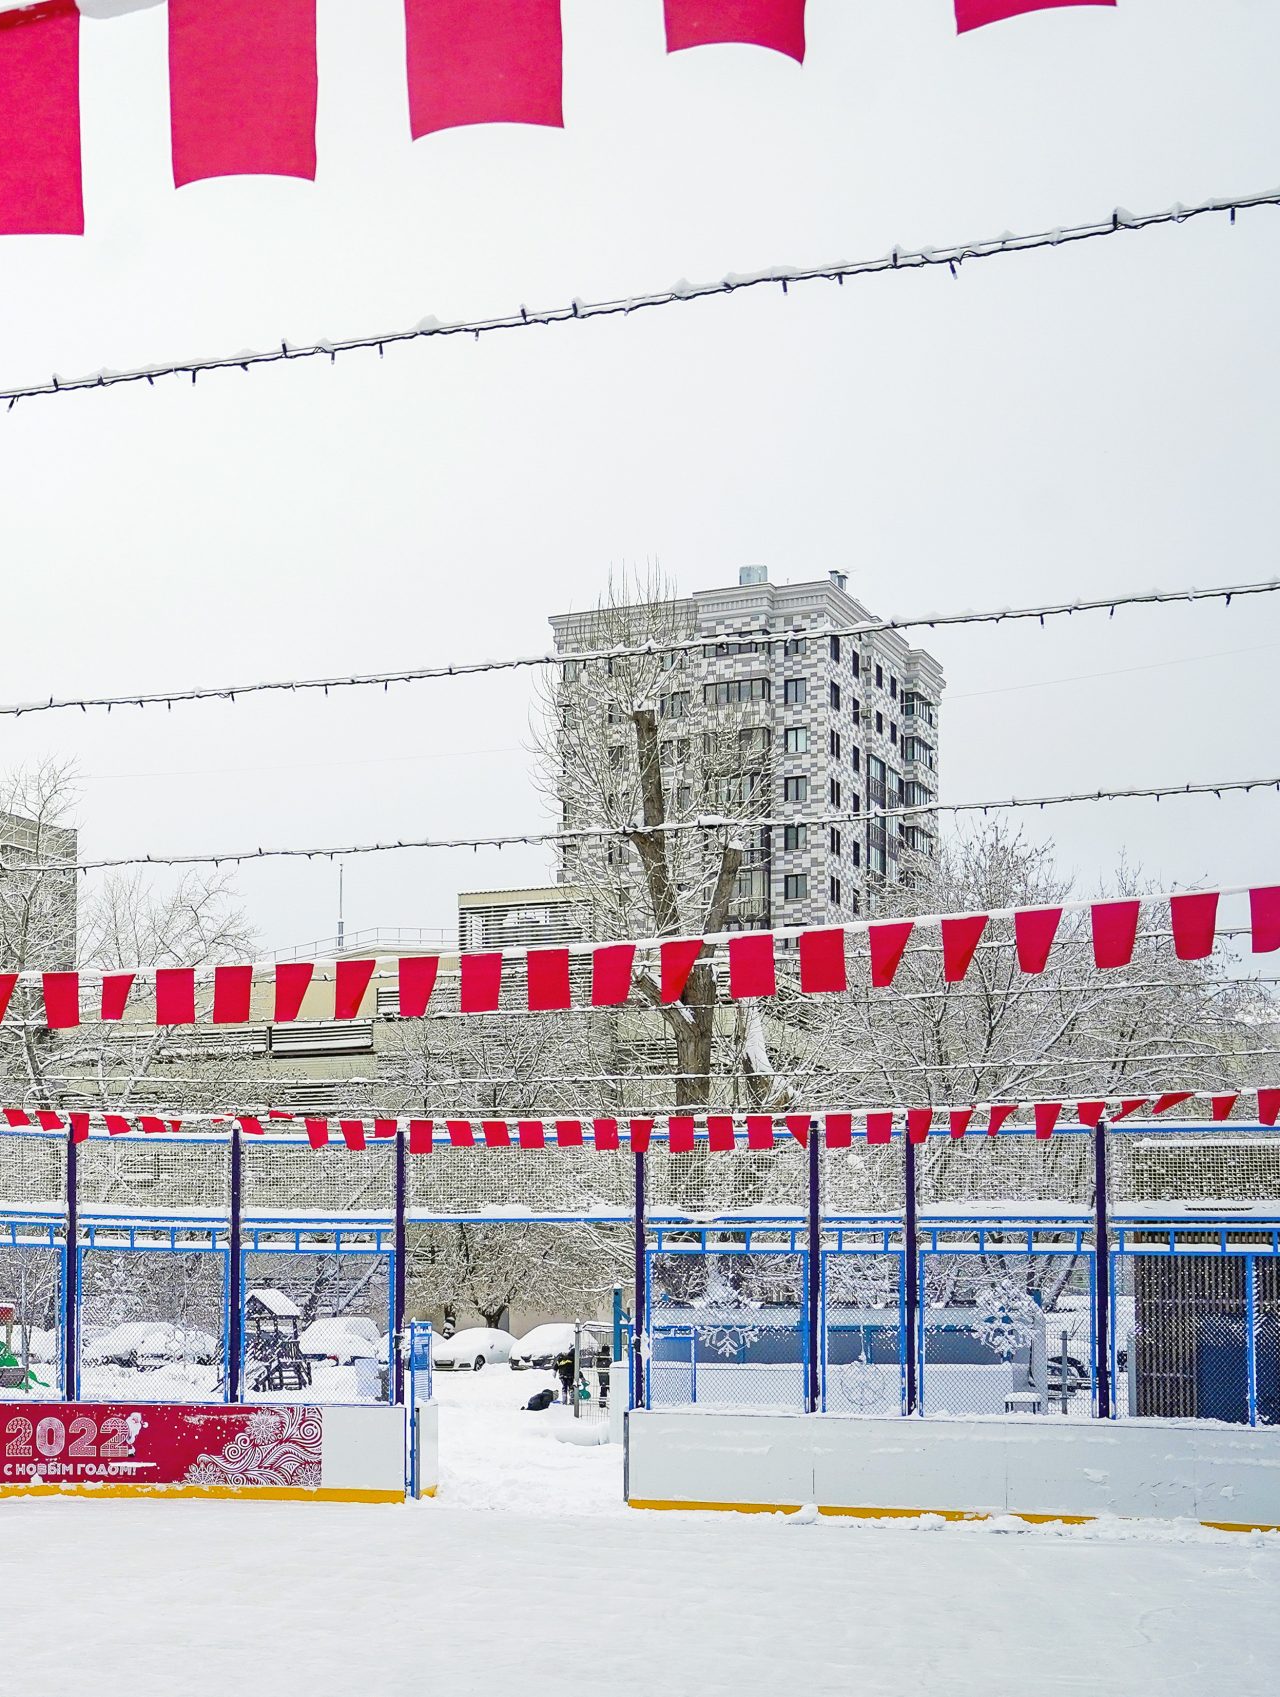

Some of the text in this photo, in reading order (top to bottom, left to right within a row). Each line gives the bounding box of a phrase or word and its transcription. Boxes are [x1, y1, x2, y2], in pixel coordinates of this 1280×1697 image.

[5, 1416, 129, 1457] 2022
[3, 1463, 137, 1476] С НОВЫМ ГОДОМ!
